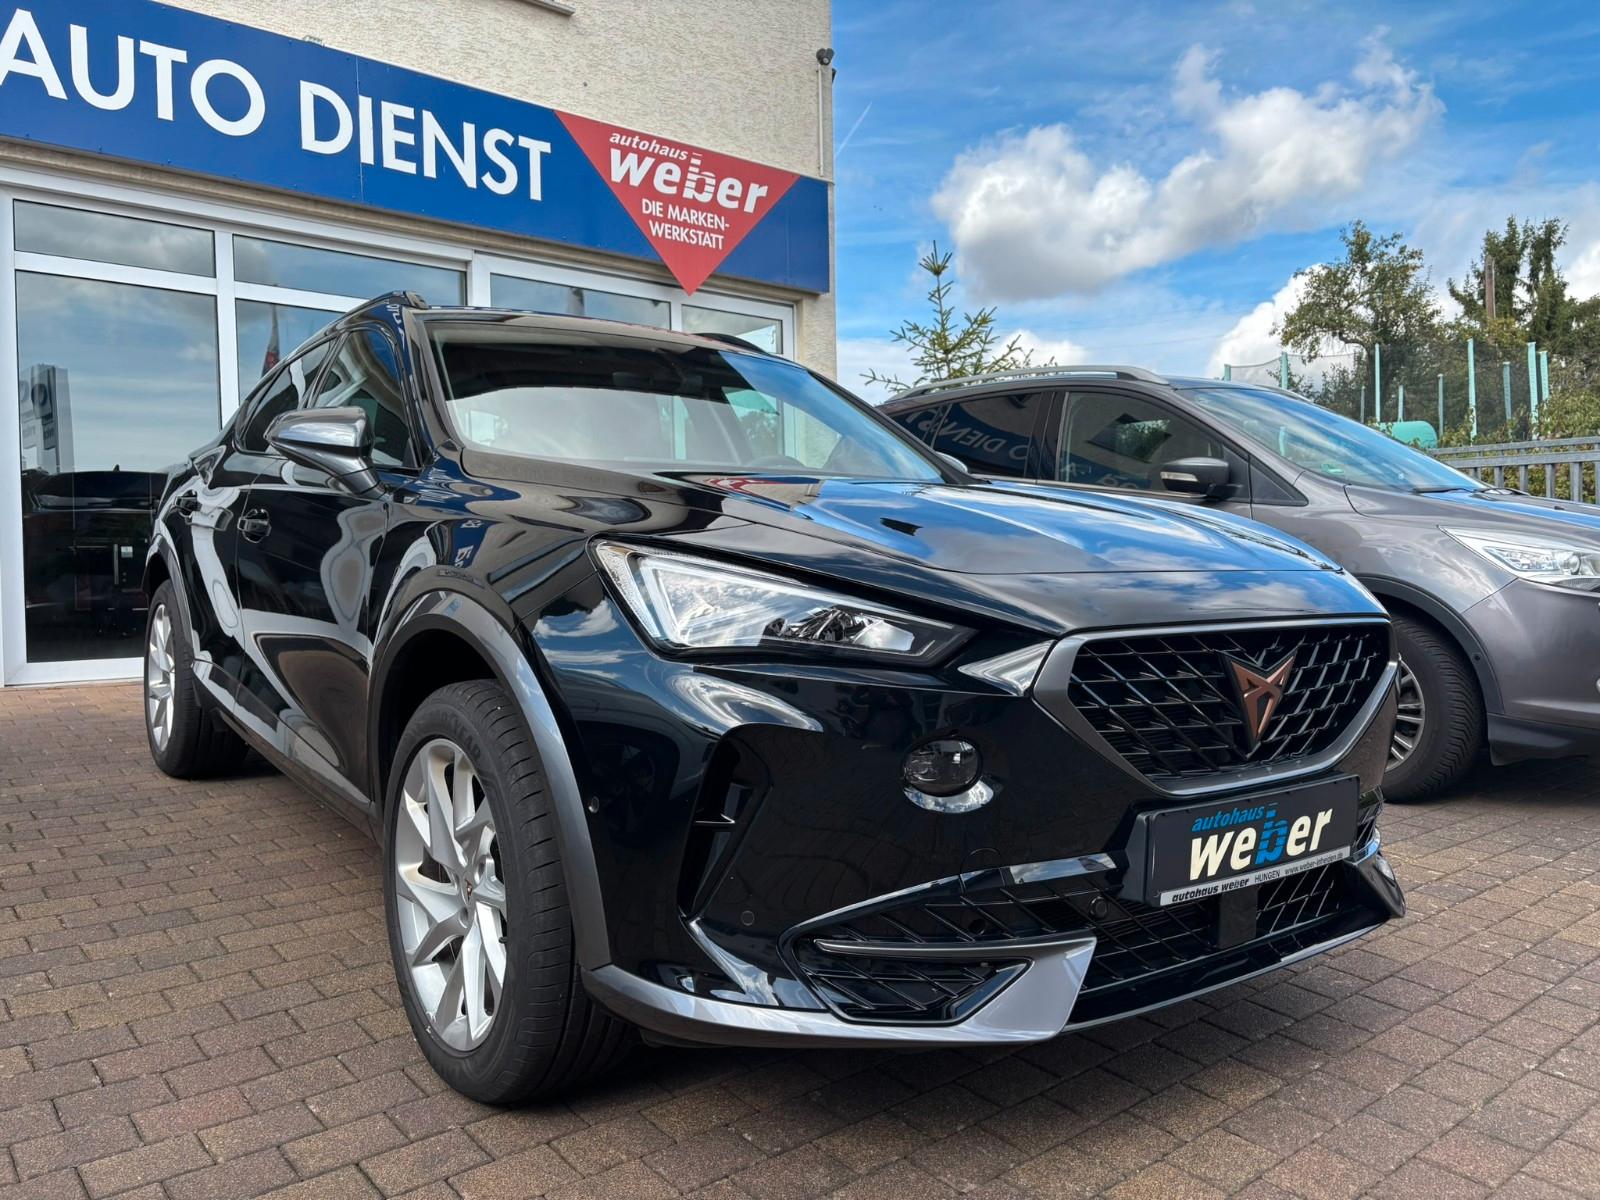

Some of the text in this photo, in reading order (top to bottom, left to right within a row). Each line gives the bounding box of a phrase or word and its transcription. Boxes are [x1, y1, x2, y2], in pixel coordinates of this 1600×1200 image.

[0, 8, 552, 202] AUTO DIENST
[609, 133, 689, 161] autohaus
[609, 148, 769, 214] weber
[641, 198, 730, 230] DIE MARKEN-
[648, 219, 725, 250] WERKSTATT
[1191, 806, 1264, 832] autohaus
[1189, 802, 1333, 880] weber
[1171, 884, 1220, 903] autohaus
[1220, 877, 1250, 892] weber
[1254, 869, 1281, 884] HUNGEN
